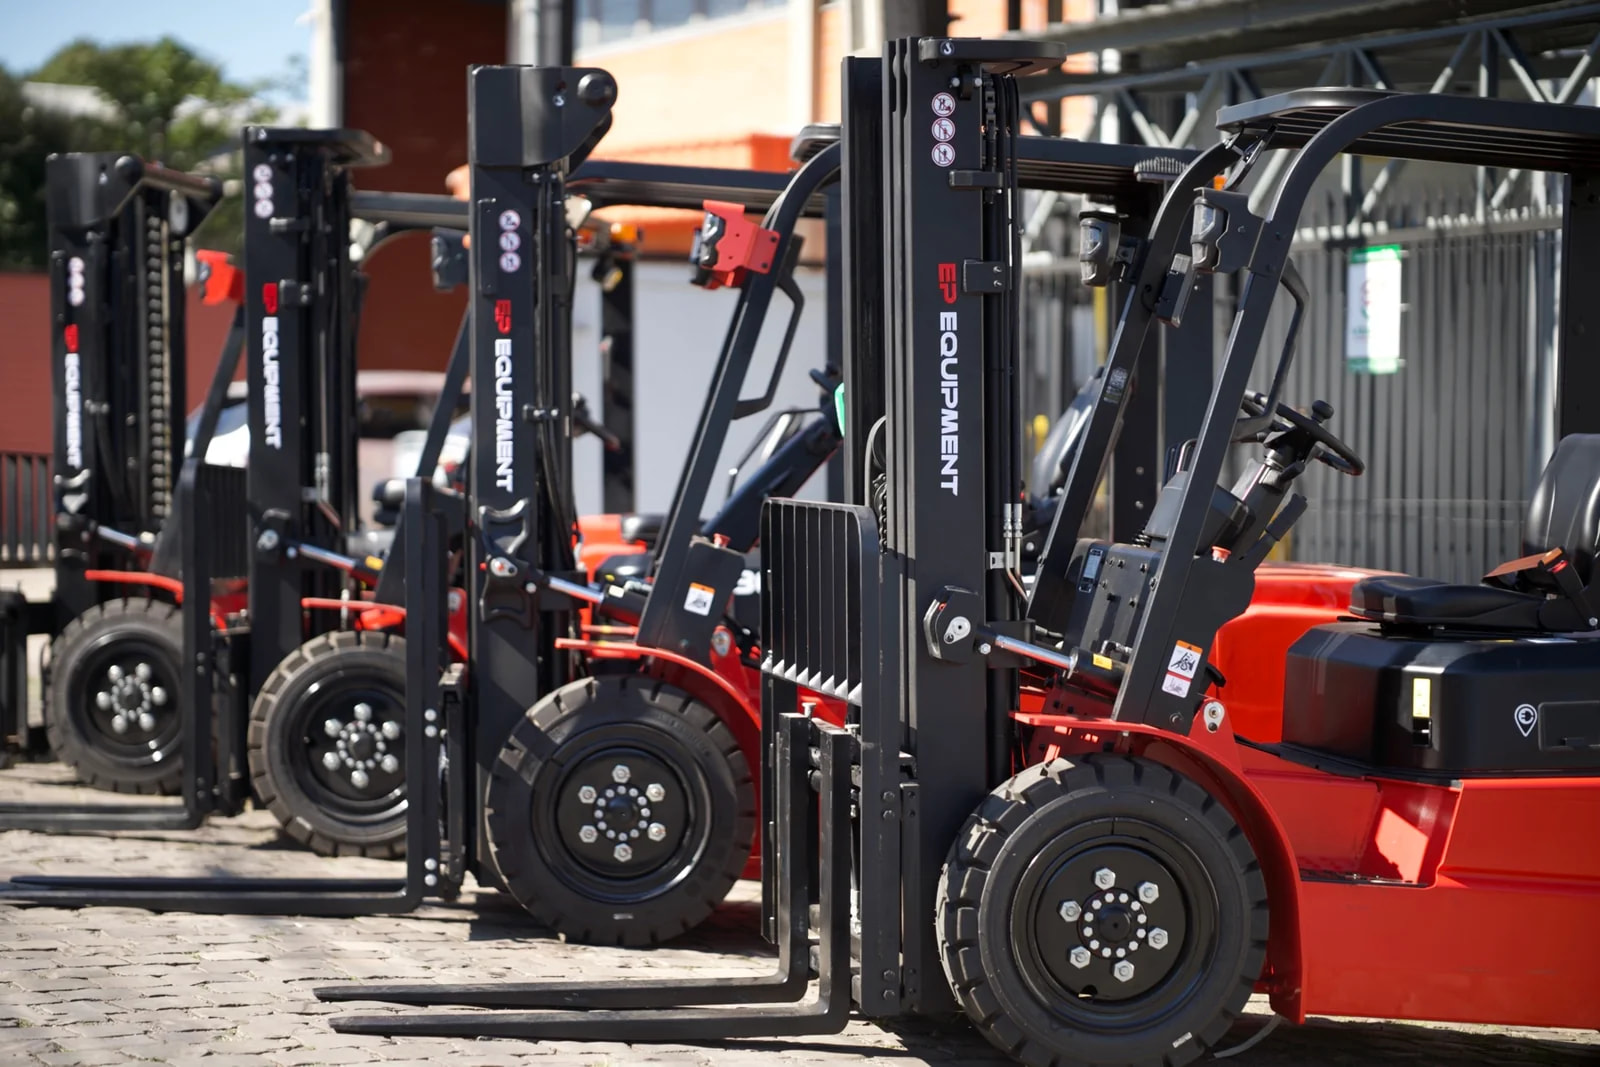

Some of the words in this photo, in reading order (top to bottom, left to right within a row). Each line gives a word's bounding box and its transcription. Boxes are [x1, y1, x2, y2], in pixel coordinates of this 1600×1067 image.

[493, 299, 512, 335] EP
[937, 262, 958, 305] EP
[262, 316, 282, 449] EQUIPMENT
[494, 338, 514, 494] EQUIPMENT
[939, 311, 959, 497] EQUIPMENT
